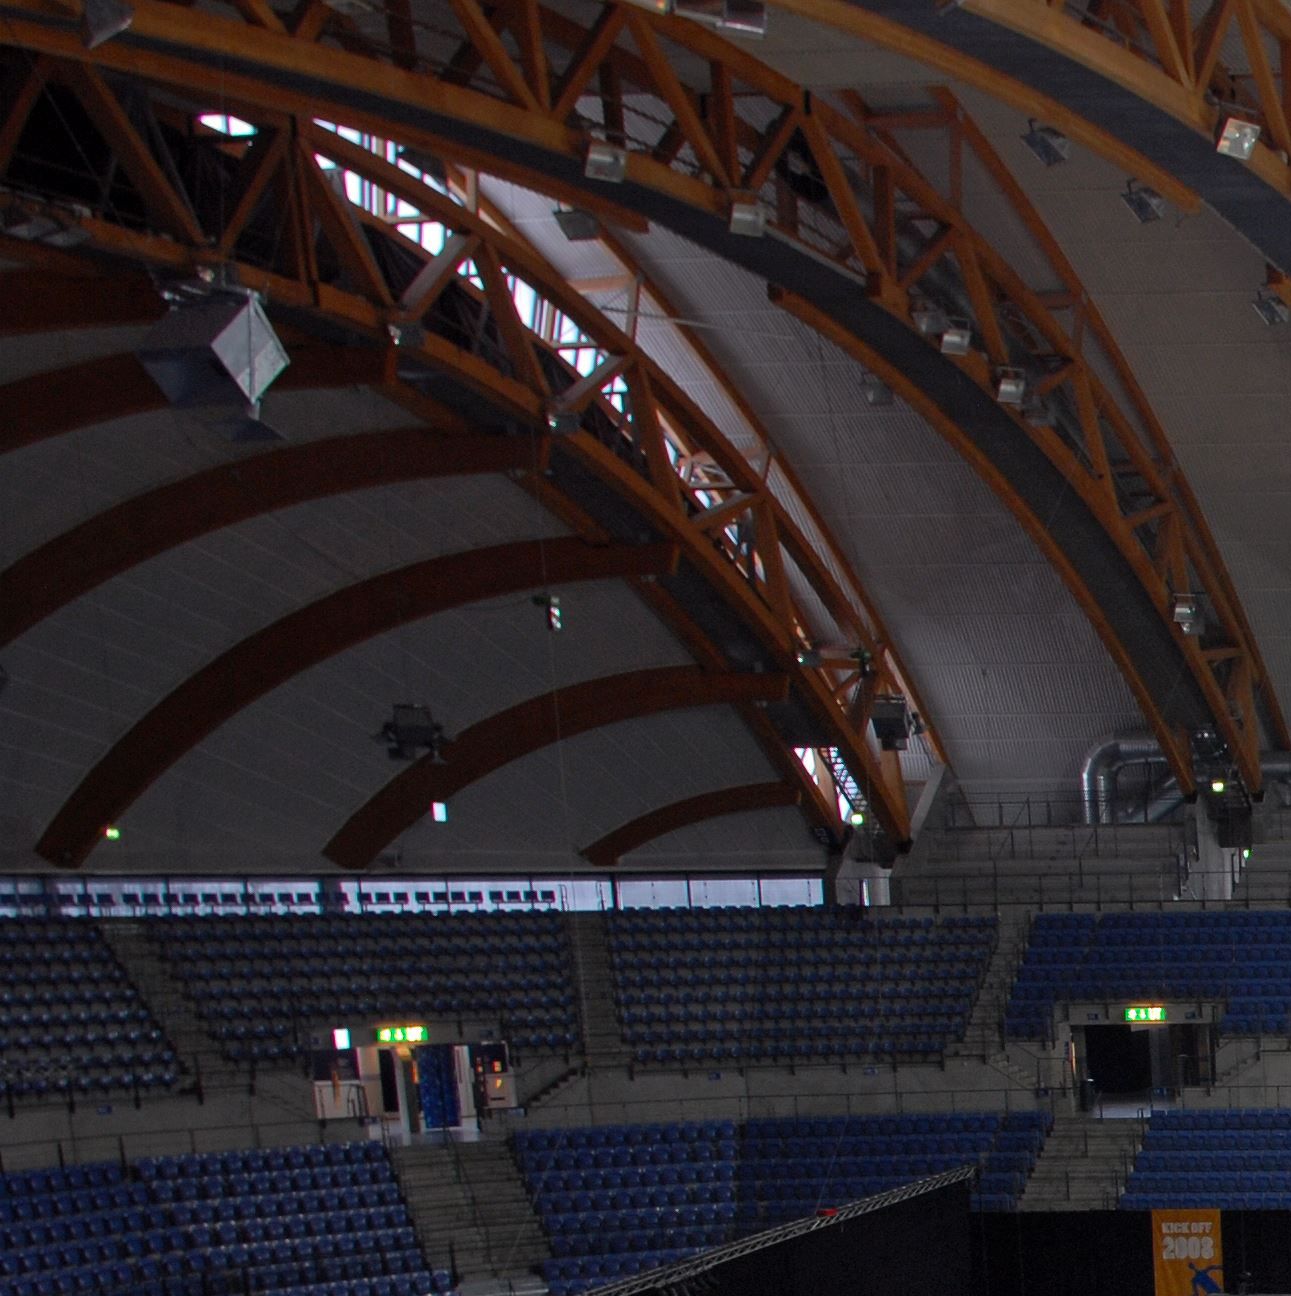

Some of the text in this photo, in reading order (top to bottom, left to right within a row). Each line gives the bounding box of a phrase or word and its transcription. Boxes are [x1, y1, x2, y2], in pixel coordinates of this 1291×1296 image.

[1162, 1222, 1213, 1233] KICK OFF
[1162, 1236, 1214, 1259] 2008
